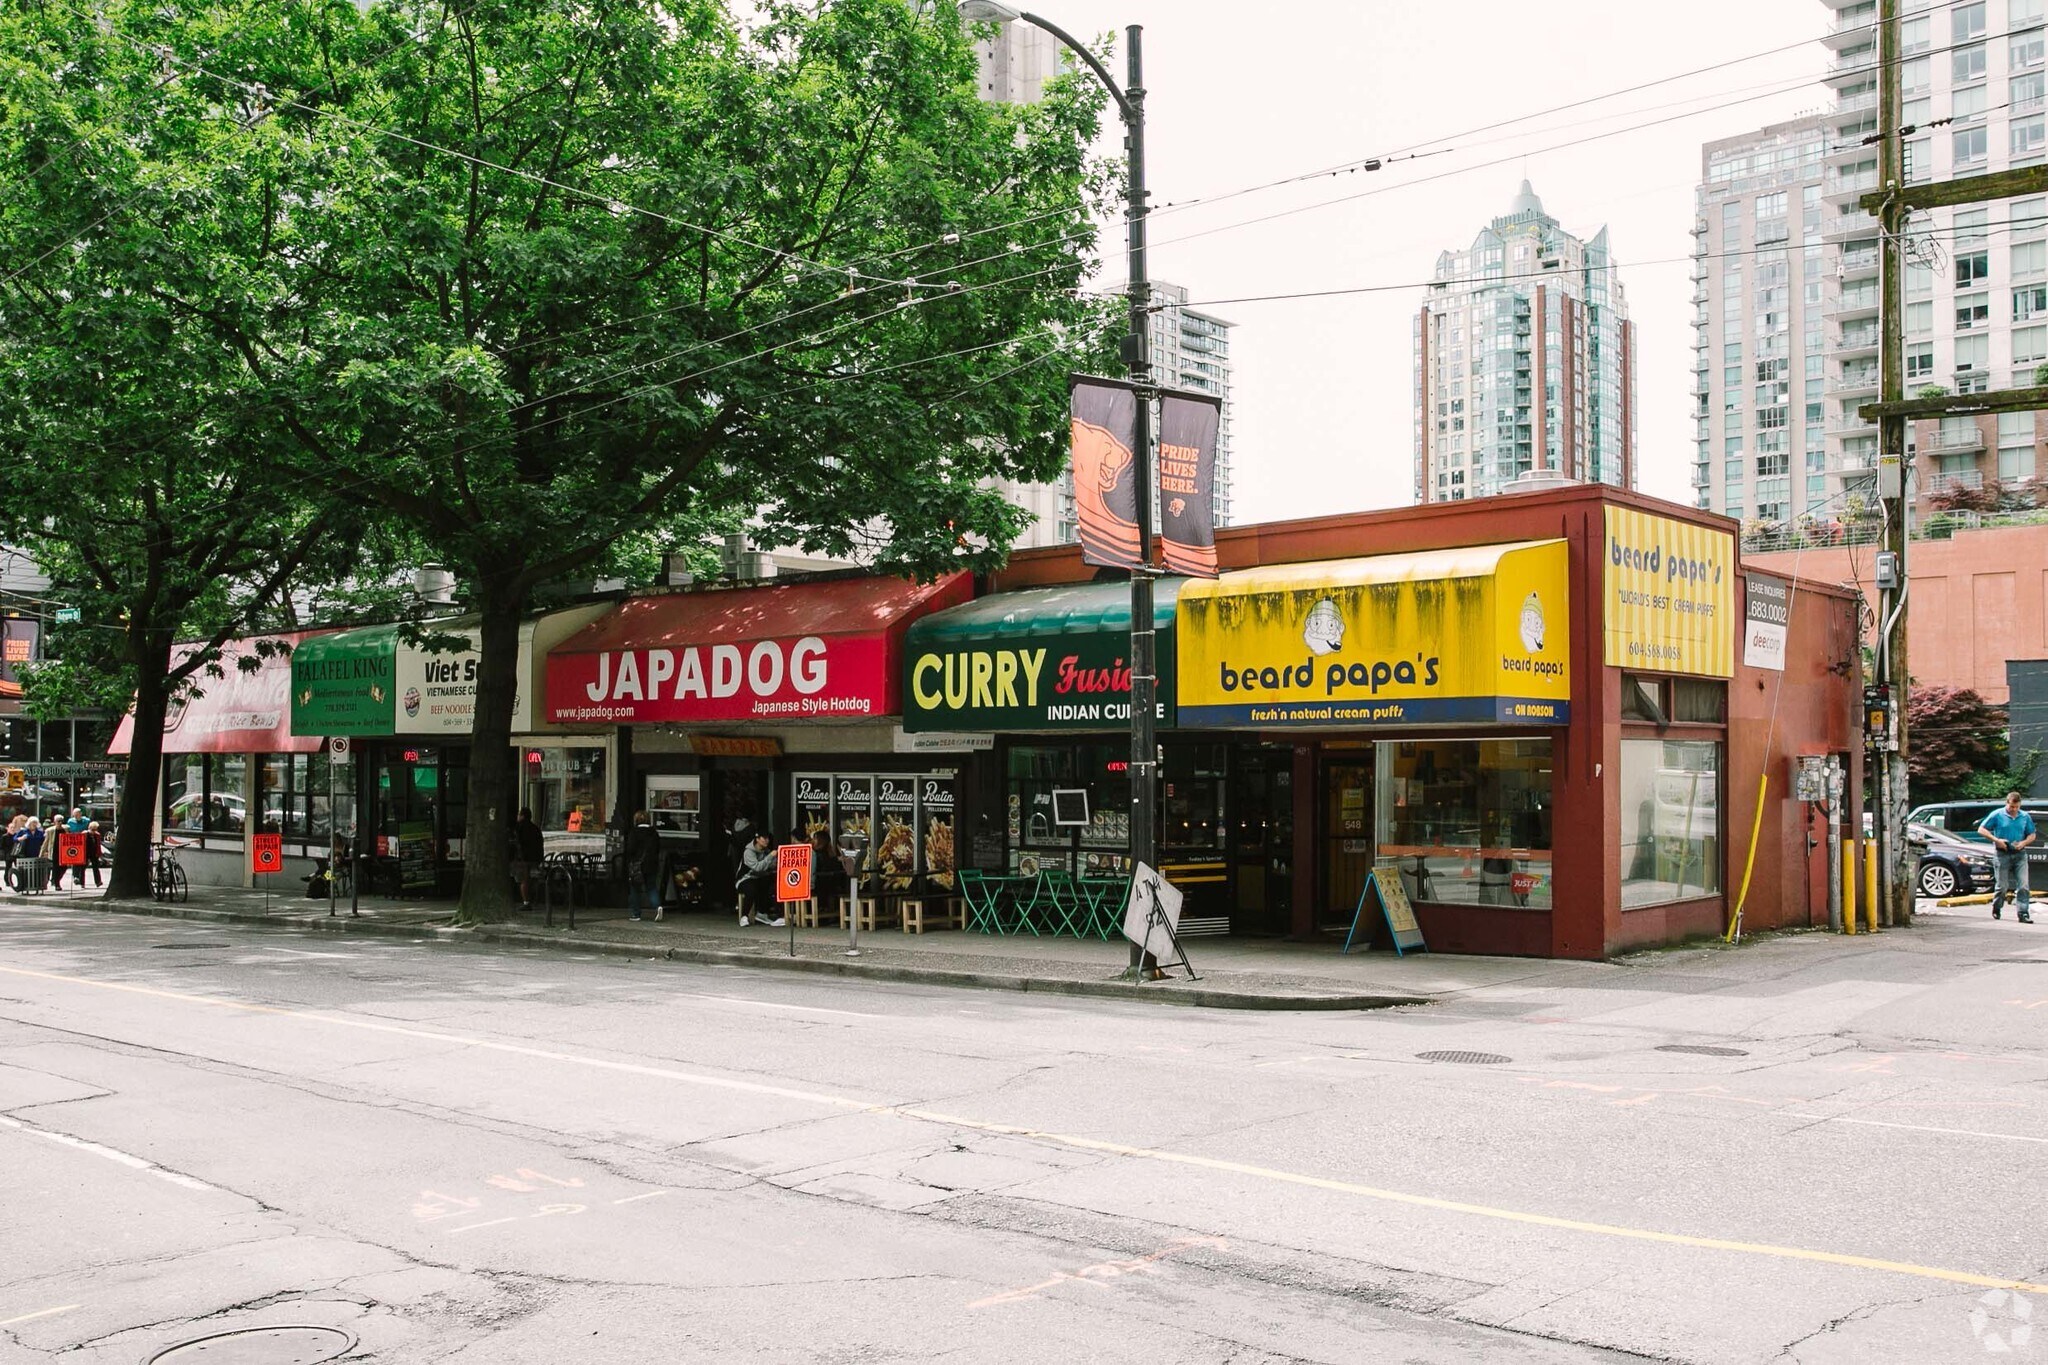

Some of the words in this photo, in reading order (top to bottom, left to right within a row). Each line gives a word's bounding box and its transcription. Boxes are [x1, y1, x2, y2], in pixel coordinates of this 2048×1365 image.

[1161, 442, 1199, 461] PRIDE
[1161, 458, 1197, 477] LIVES
[1161, 475, 1199, 494] HERE.
[1611, 536, 1660, 574] beard
[1667, 553, 1721, 587] papa's
[1748, 581, 1764, 594] LEASE
[1653, 595, 1670, 610] BEST
[1674, 598, 1695, 614] CREAM
[1751, 600, 1787, 623] 683.0002
[1753, 631, 1780, 655] deecorp
[298, 660, 350, 681] FALAFEL
[353, 656, 388, 678] KING
[425, 658, 460, 683] Viet
[586, 637, 827, 702] JAPADOG
[1220, 656, 1314, 692] beard
[1326, 652, 1439, 696] papa's
[1502, 654, 1531, 672] beard
[1534, 660, 1564, 677] papa's
[912, 648, 1047, 710] CURRY
[426, 686, 467, 697] VIETNAMESE
[430, 704, 444, 714] BEEF
[445, 704, 471, 714] NOODLE
[556, 706, 635, 720] www.japadog.com
[752, 699, 800, 714] Japanese
[801, 697, 829, 712] Style
[830, 696, 870, 712] Hotdog
[1047, 704, 1100, 720] INDIAN
[1104, 703, 1165, 720] CUIE
[1251, 708, 1287, 721] fresh'n
[1290, 706, 1332, 720] natural
[1334, 707, 1370, 719] cream
[1373, 705, 1403, 720] puffs
[404, 751, 419, 762] OPEN
[528, 752, 542, 762] OPEN
[562, 760, 580, 771] SUB
[24, 766, 88, 777] ARBUCKS
[1107, 762, 1128, 771] OPEN
[797, 780, 831, 801] Poutine
[837, 780, 871, 801] Poutine
[878, 781, 914, 802] Poutine
[922, 781, 954, 803] Poutin
[1344, 819, 1362, 829] 548
[782, 848, 808, 859] STREET
[782, 858, 808, 868] REPAIR
[1513, 879, 1531, 887] JUST
